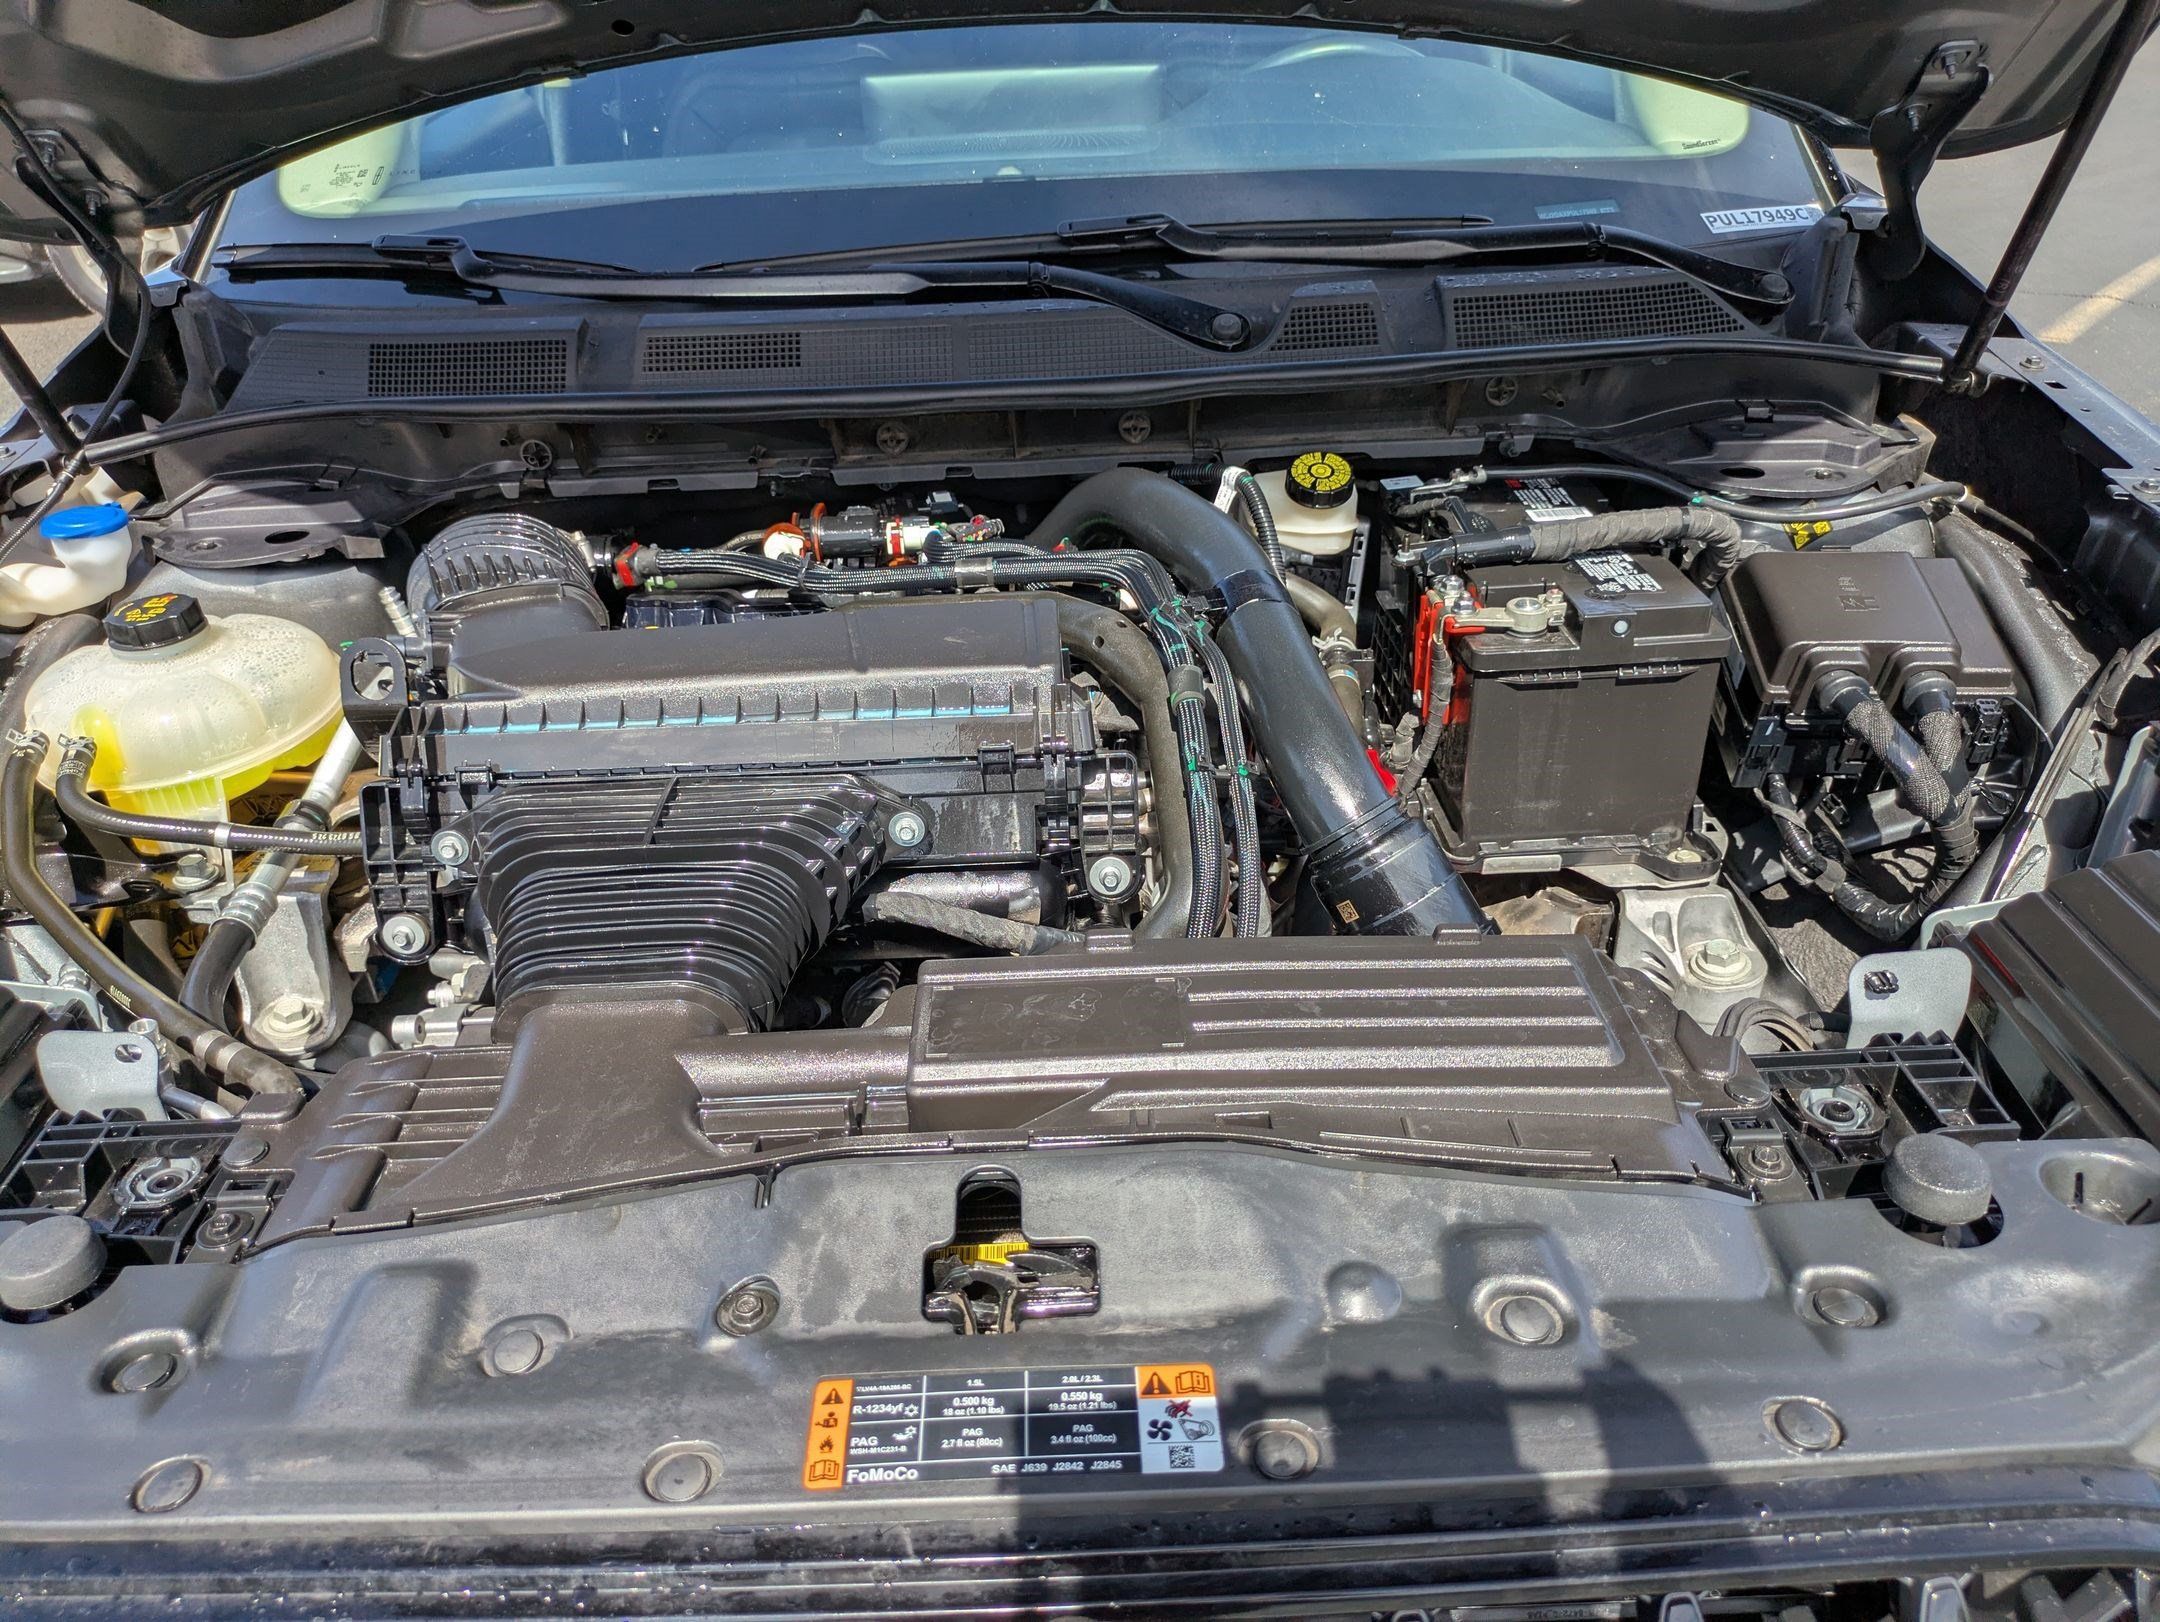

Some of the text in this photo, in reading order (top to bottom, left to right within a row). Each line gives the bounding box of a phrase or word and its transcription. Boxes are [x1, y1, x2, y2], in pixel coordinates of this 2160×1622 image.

[1704, 207, 1809, 228] PUL17949C
[966, 1378, 985, 1387] 1.5L
[1062, 1375, 1079, 1384] 2.0L
[1085, 1374, 1103, 1383] 2.3L
[953, 1395, 994, 1407] 0.500 kg
[1061, 1391, 1103, 1402] 0.550 kg
[853, 1402, 904, 1415] R-1234yf
[943, 1407, 953, 1416] 18
[954, 1408, 965, 1416] oz
[988, 1405, 1005, 1415] lbs)
[1048, 1402, 1066, 1411] 19.5
[1100, 1400, 1117, 1410] lbs)
[962, 1427, 984, 1437] PAG
[1072, 1424, 1094, 1433] PAG
[851, 1436, 878, 1447] PAG
[941, 1439, 955, 1449] 2.7
[965, 1439, 976, 1447] oz
[976, 1437, 1003, 1448] (80cc)
[1050, 1435, 1065, 1444] 3.4
[1073, 1435, 1084, 1443] oz
[1085, 1432, 1117, 1444] (100cc)
[991, 1459, 1122, 1474] SAE J639 J2842 J2845
[847, 1466, 919, 1483] FoMoCo
